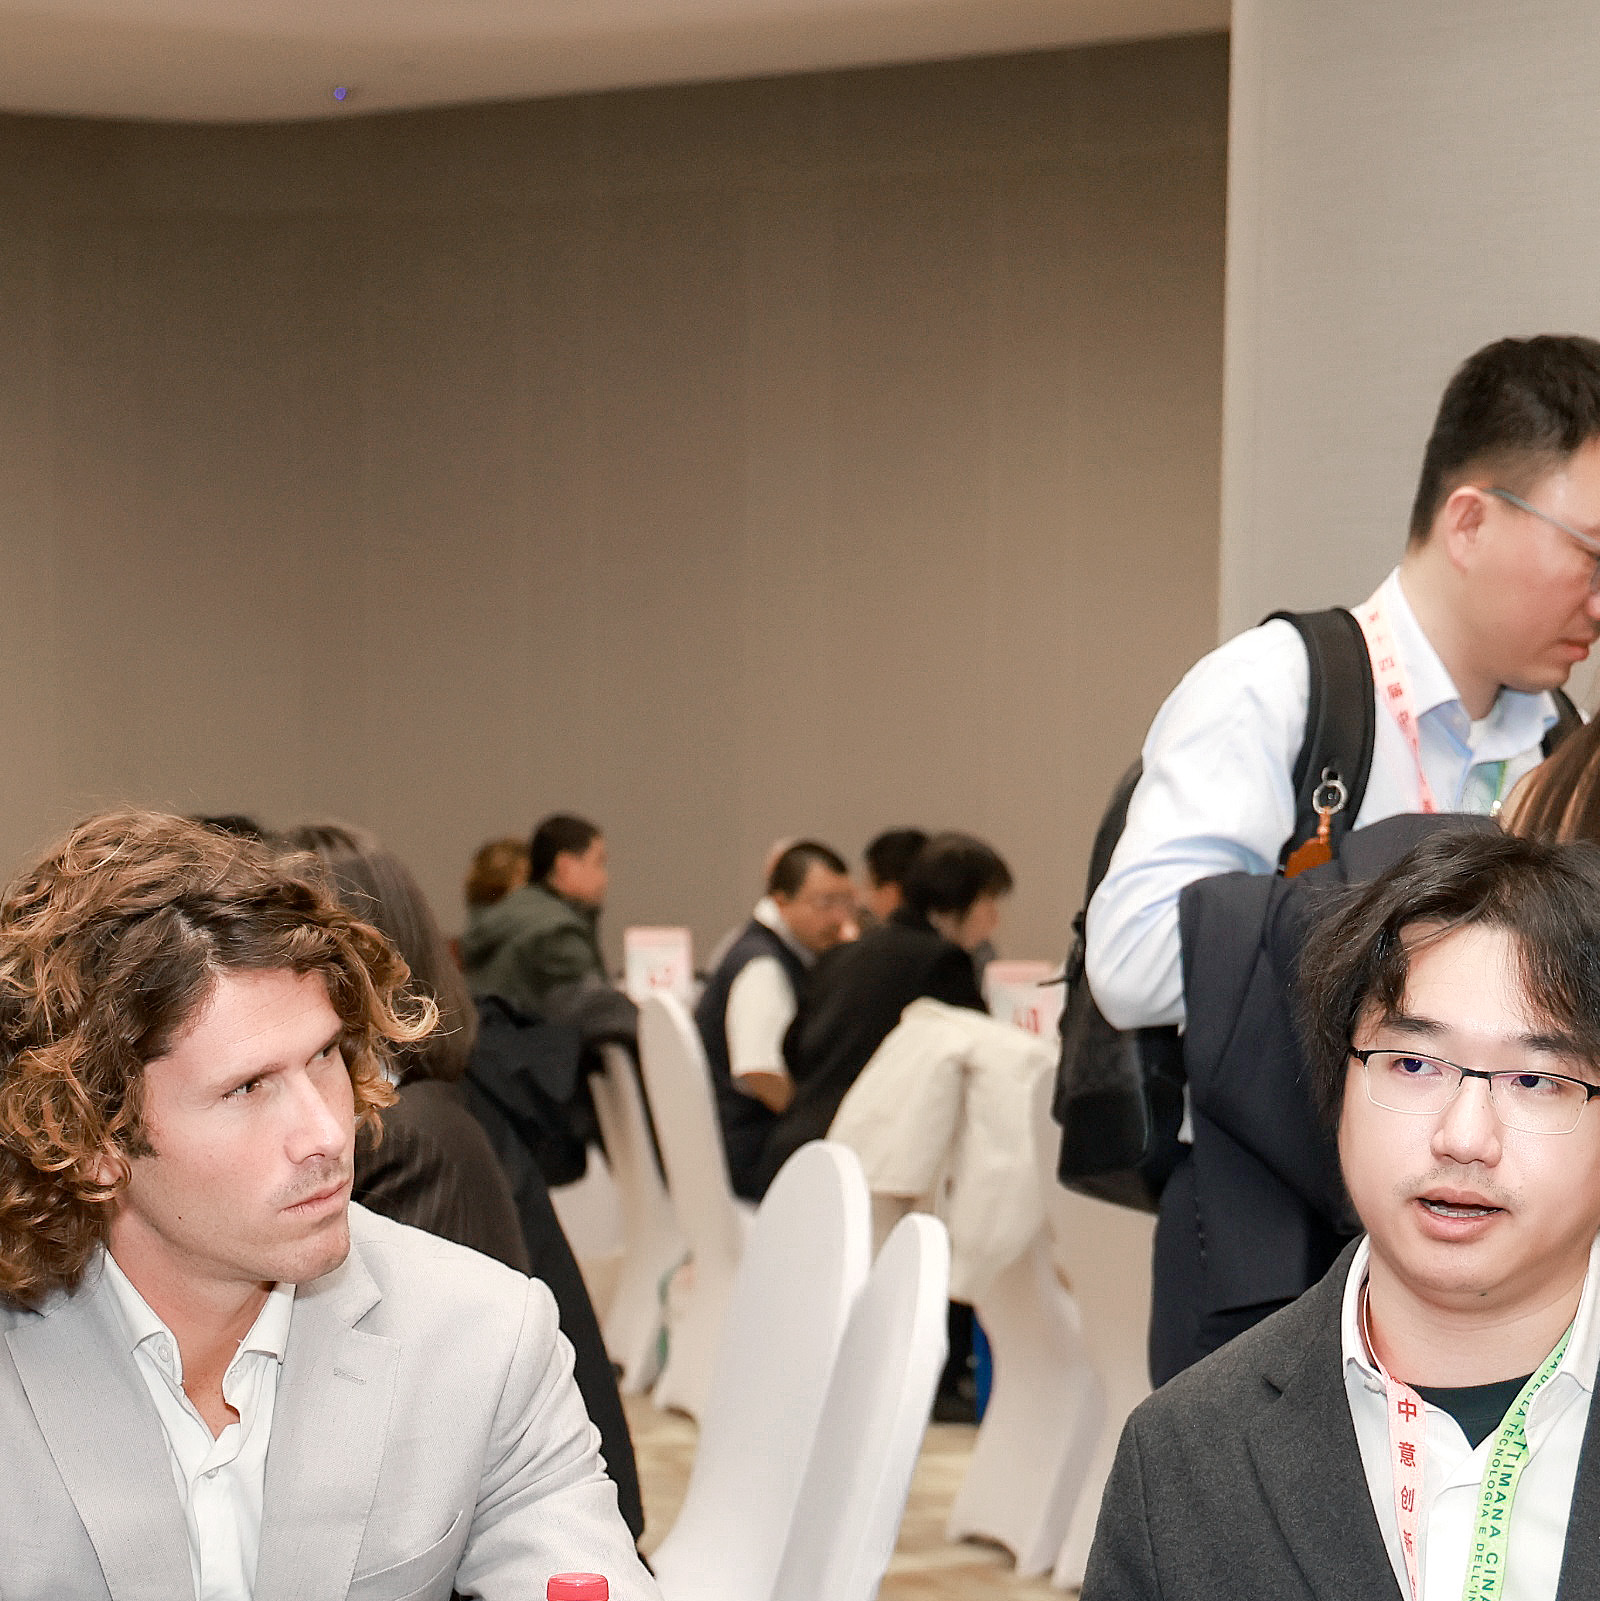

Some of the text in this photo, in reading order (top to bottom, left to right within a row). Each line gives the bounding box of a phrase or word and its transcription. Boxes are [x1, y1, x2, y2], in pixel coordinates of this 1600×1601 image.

[1481, 1421, 1519, 1518] TECNOLOGIA
[1489, 1428, 1527, 1538] TTIMANA
[1478, 1526, 1487, 1535] E
